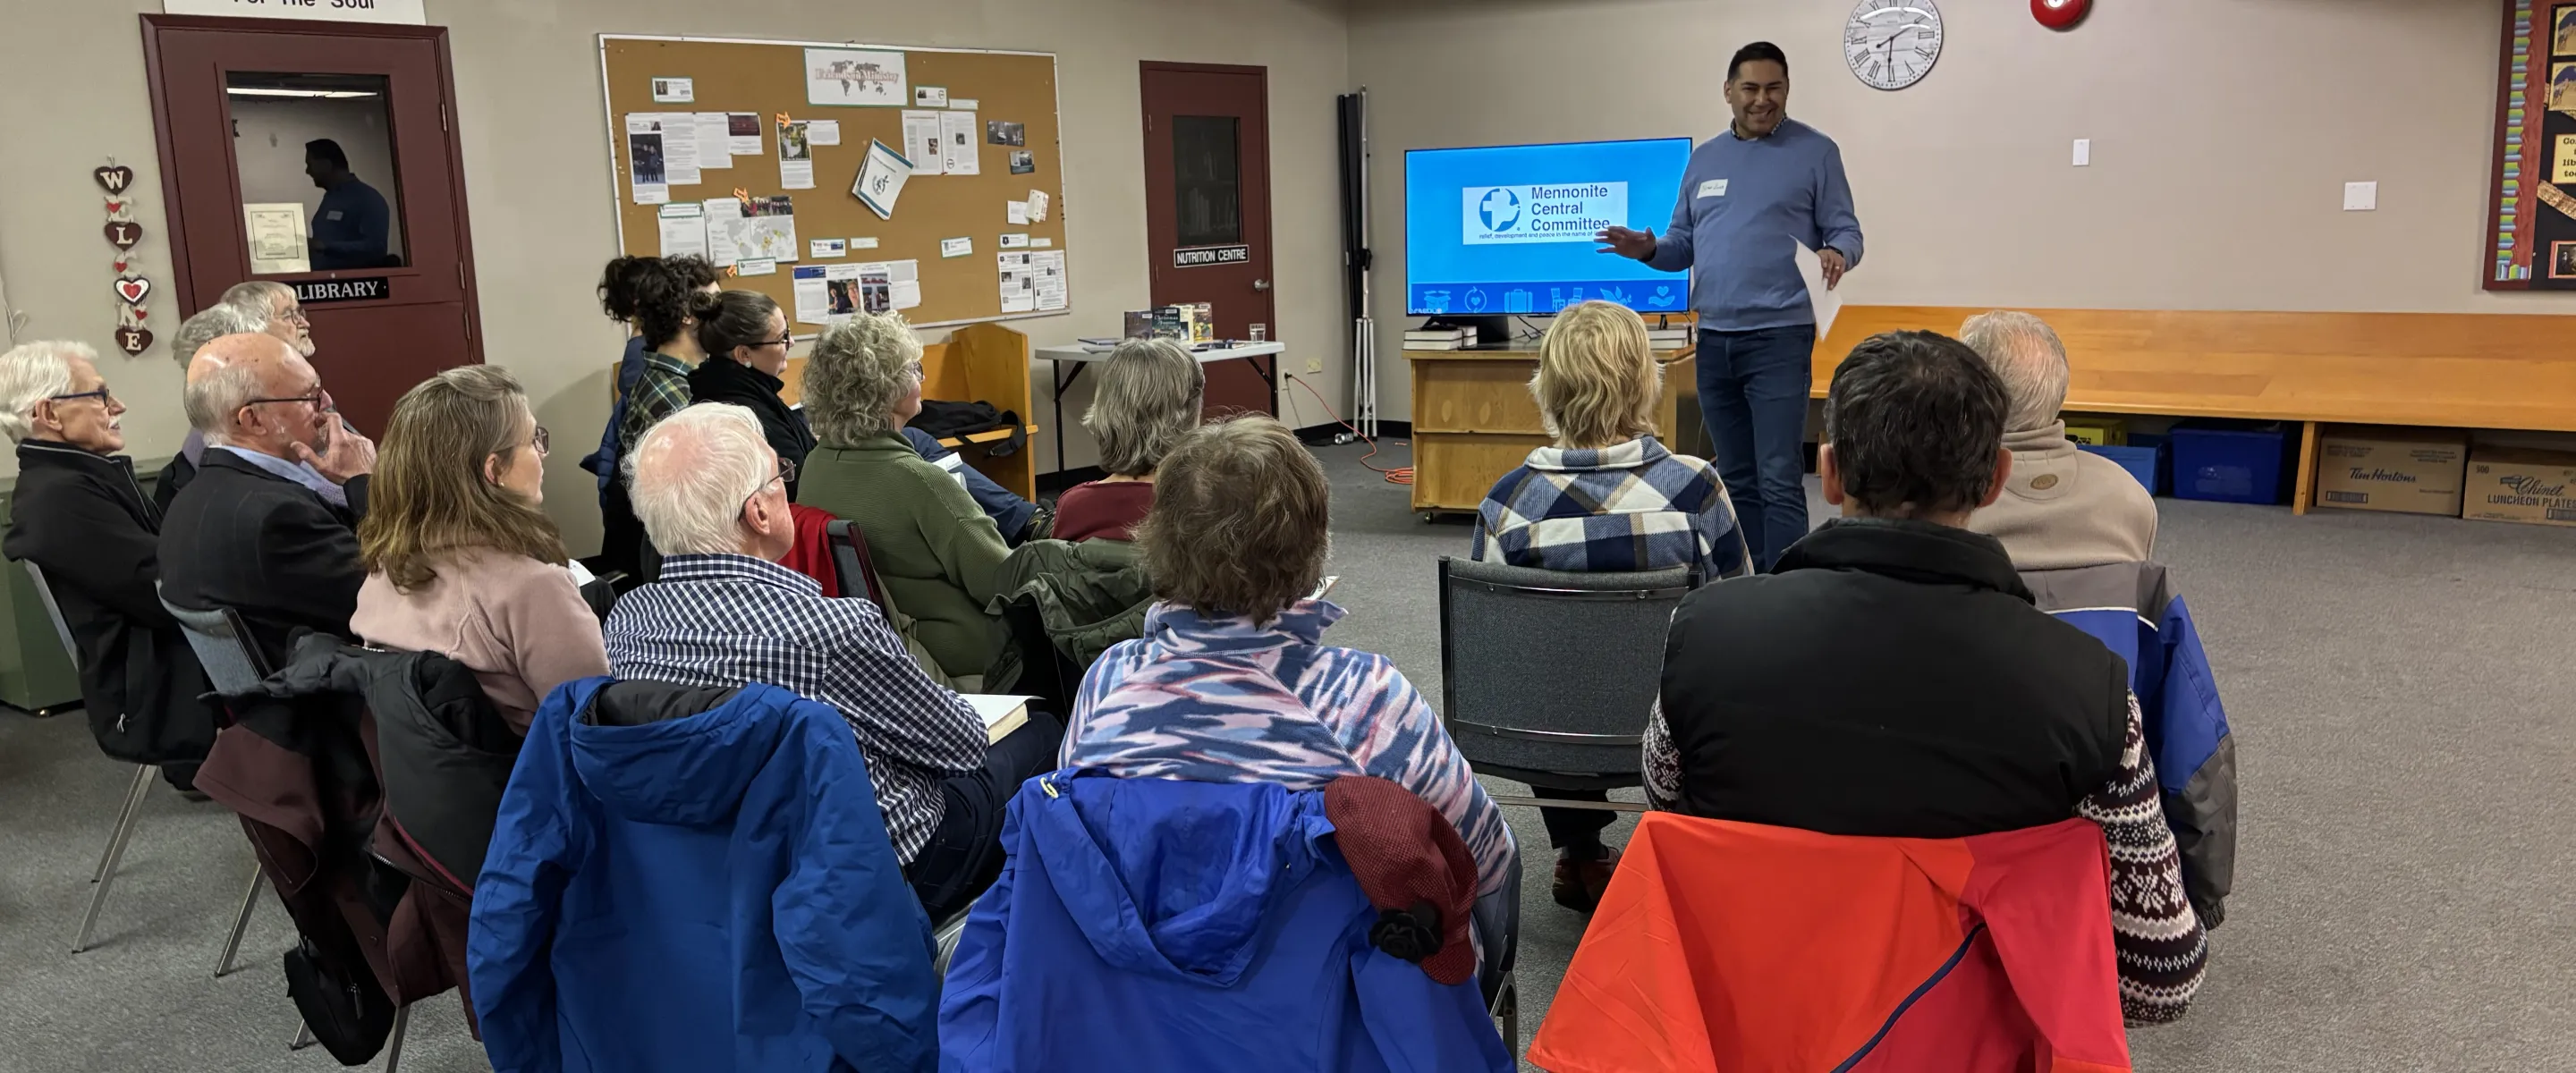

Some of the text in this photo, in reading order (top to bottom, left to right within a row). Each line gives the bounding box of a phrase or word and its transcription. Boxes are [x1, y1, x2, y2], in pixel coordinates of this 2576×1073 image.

[1531, 184, 1608, 199] Mennonite
[1531, 201, 1583, 215] Central
[1531, 217, 1611, 232] Committee
[1177, 249, 1246, 264] NUTRITION CENTRE
[296, 281, 378, 300] LIBRARY
[2349, 467, 2417, 483] Tim Hortons
[2487, 494, 2539, 507] LUNCHEON
